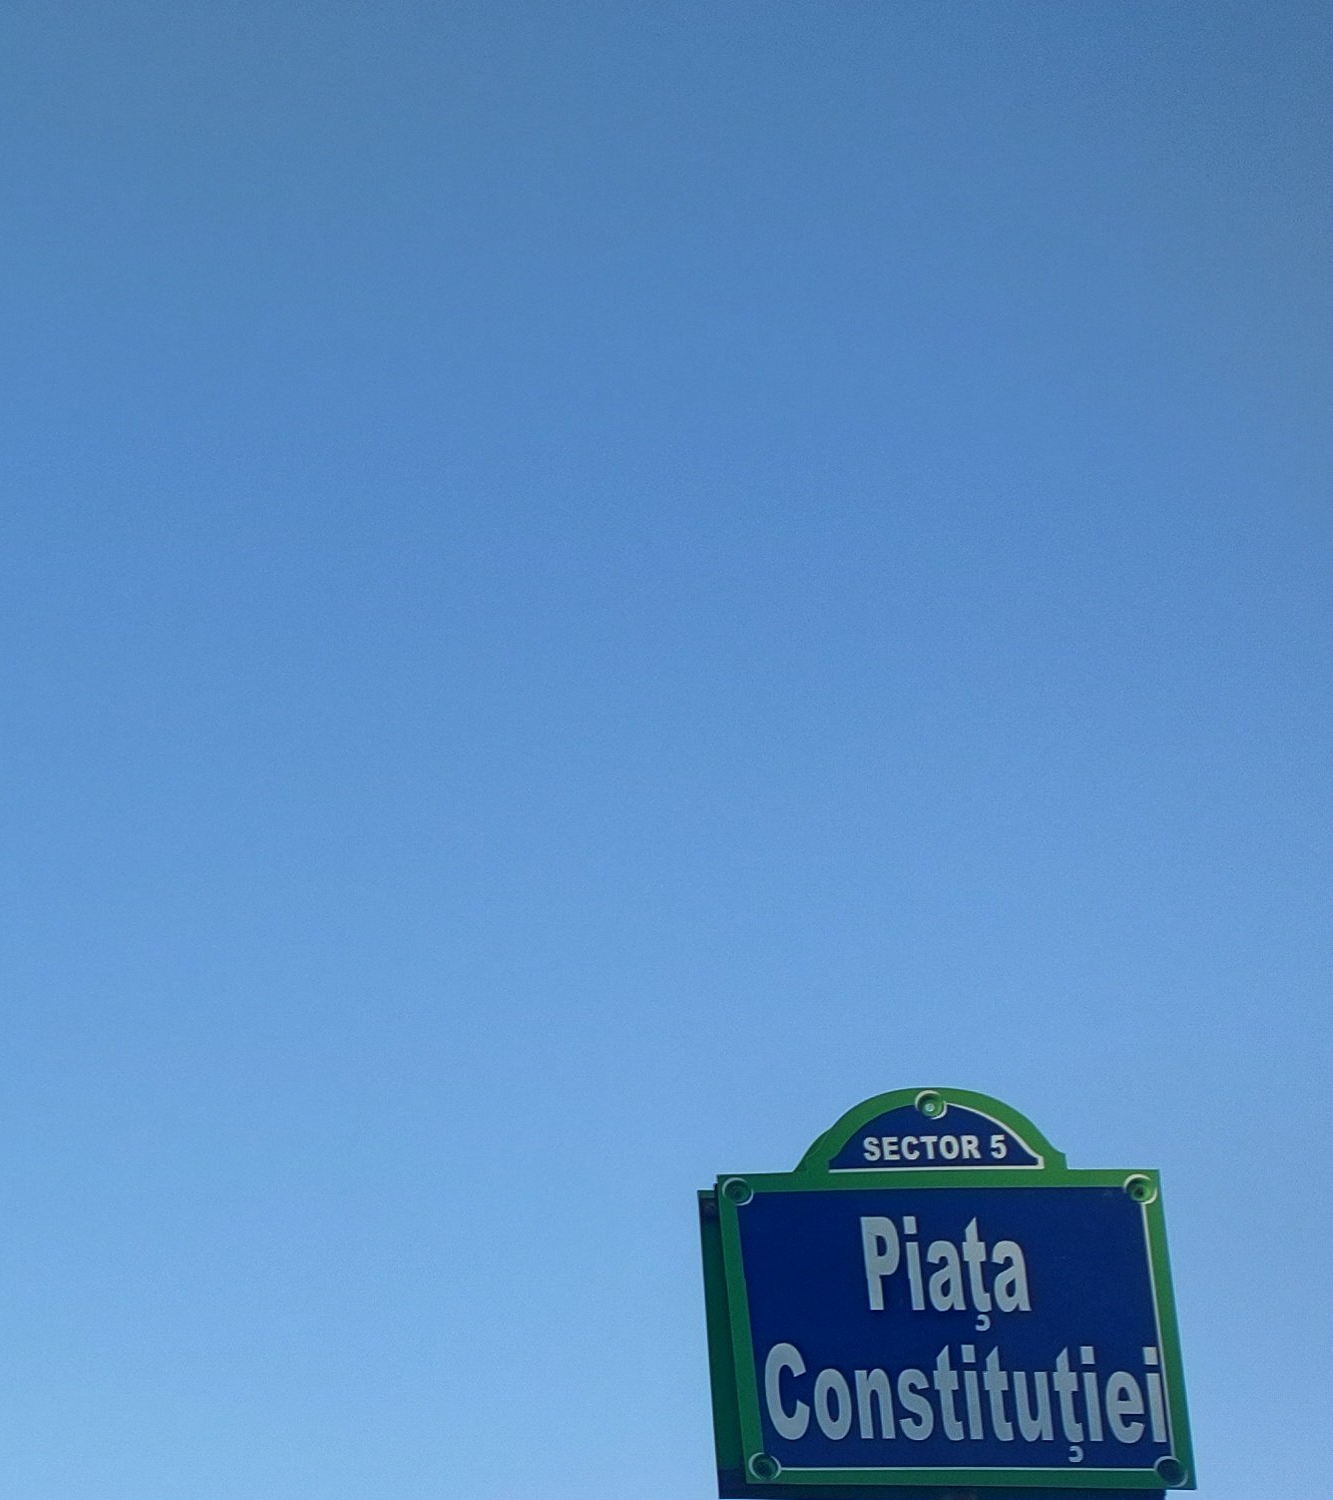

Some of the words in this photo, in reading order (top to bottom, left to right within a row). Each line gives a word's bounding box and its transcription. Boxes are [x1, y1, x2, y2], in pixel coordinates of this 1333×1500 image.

[863, 1135, 981, 1161] SECTOR
[990, 1134, 1007, 1158] 5
[860, 1216, 1032, 1331] Piața
[764, 1342, 1167, 1462] Constituției
